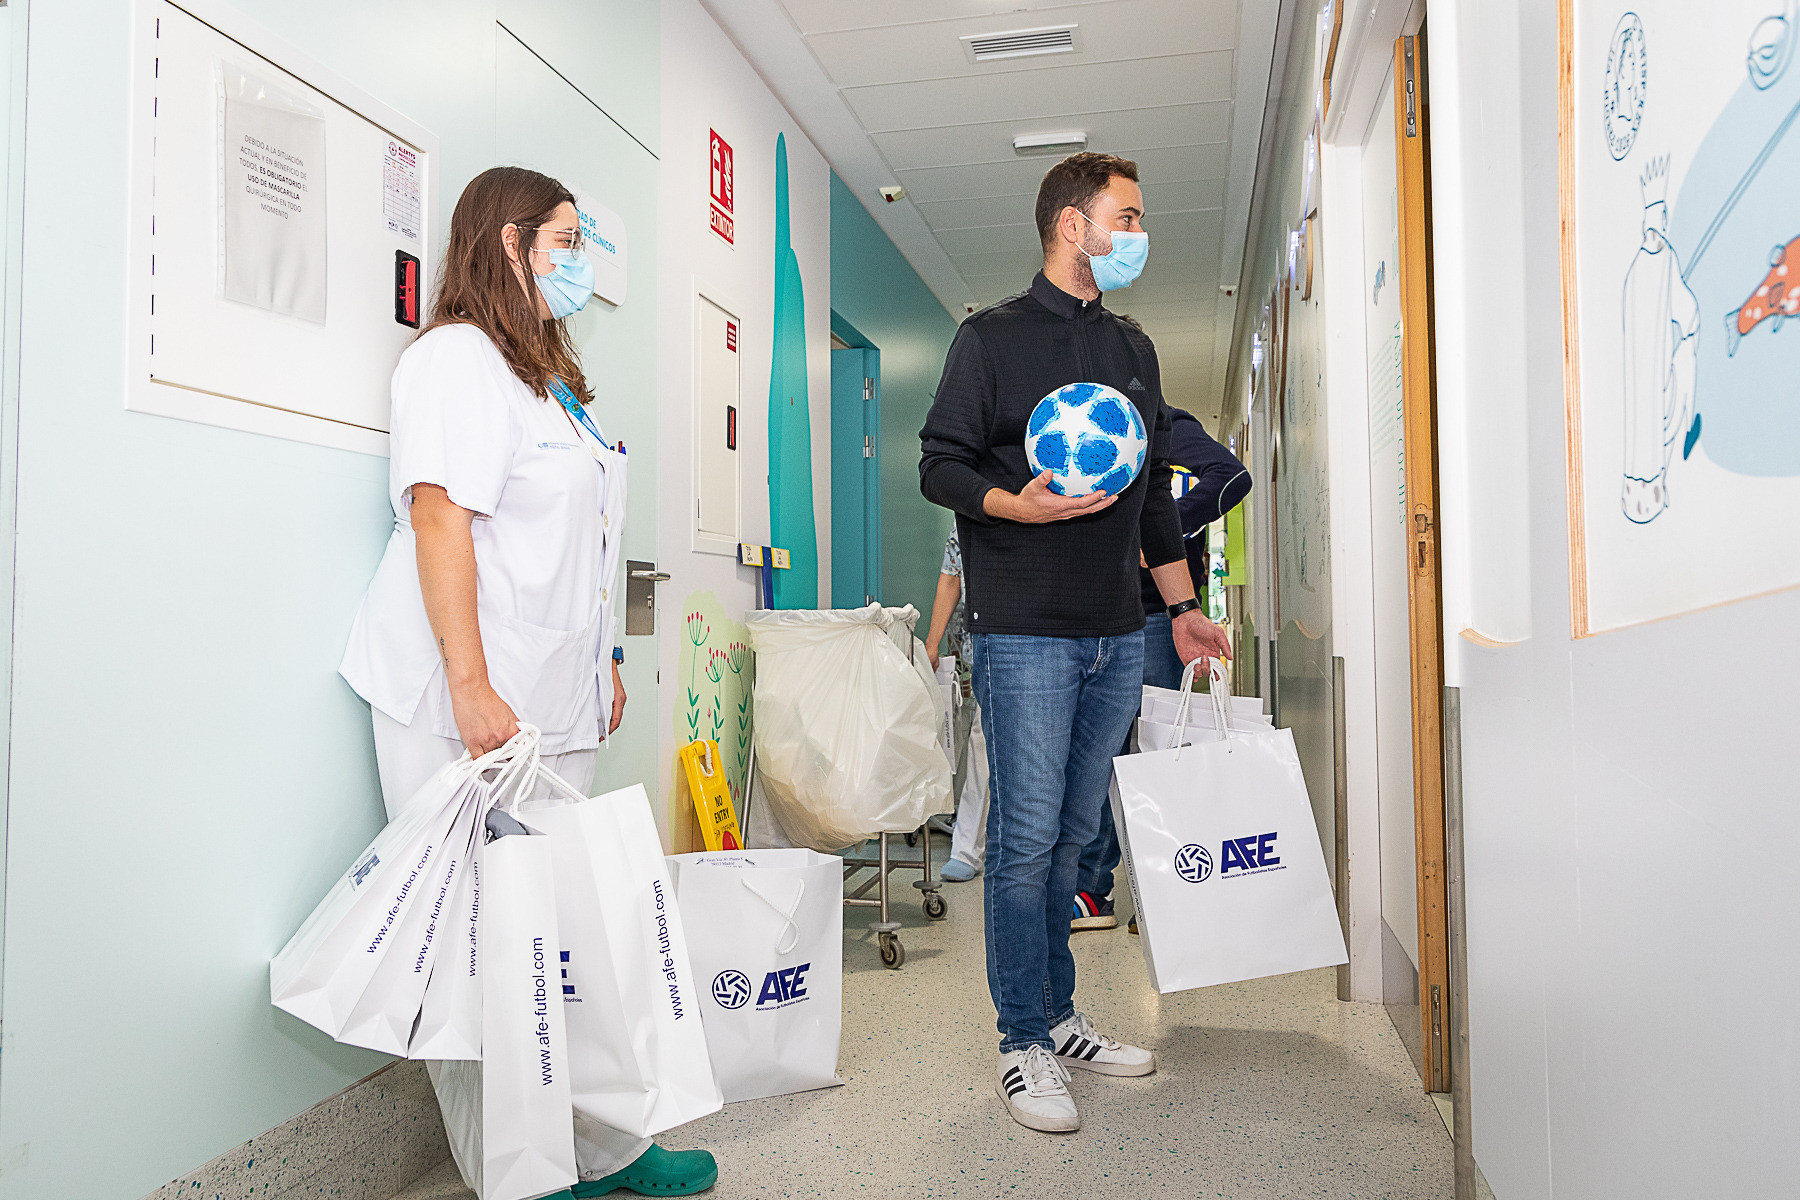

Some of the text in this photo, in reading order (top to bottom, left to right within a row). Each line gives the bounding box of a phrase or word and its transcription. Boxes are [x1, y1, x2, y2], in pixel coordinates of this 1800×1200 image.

[240, 145, 261, 161] ACTUAL
[265, 156, 273, 166] EN
[273, 160, 300, 177] BENEFICIO
[300, 171, 308, 180] DE
[244, 134, 304, 167] DEBIDO A LA SITUACIÓN
[239, 156, 309, 193] TODOS, ES OBLIGATORIO EL
[247, 173, 301, 201] USO DE MASCARILLA
[245, 185, 302, 213] QUIRÚRGICA EN TODO
[260, 202, 289, 220] MOMENTO
[576, 208, 597, 230] DAD DE
[710, 206, 734, 241] EXTINTOR
[580, 224, 616, 255] YOS CLÍNICOS
[713, 807, 730, 824] ENTRY
[714, 794, 723, 808] NO
[1220, 831, 1281, 874] AFE
[366, 845, 433, 953] www.afe-futbol.com
[413, 860, 457, 973] www.afe-futbol.com
[468, 861, 480, 977] www.afe-futbol.com
[653, 879, 684, 1021] www.afe-futbol.com
[755, 962, 811, 1006] AFE
[531, 937, 553, 1086] www.afe-futbol.com
